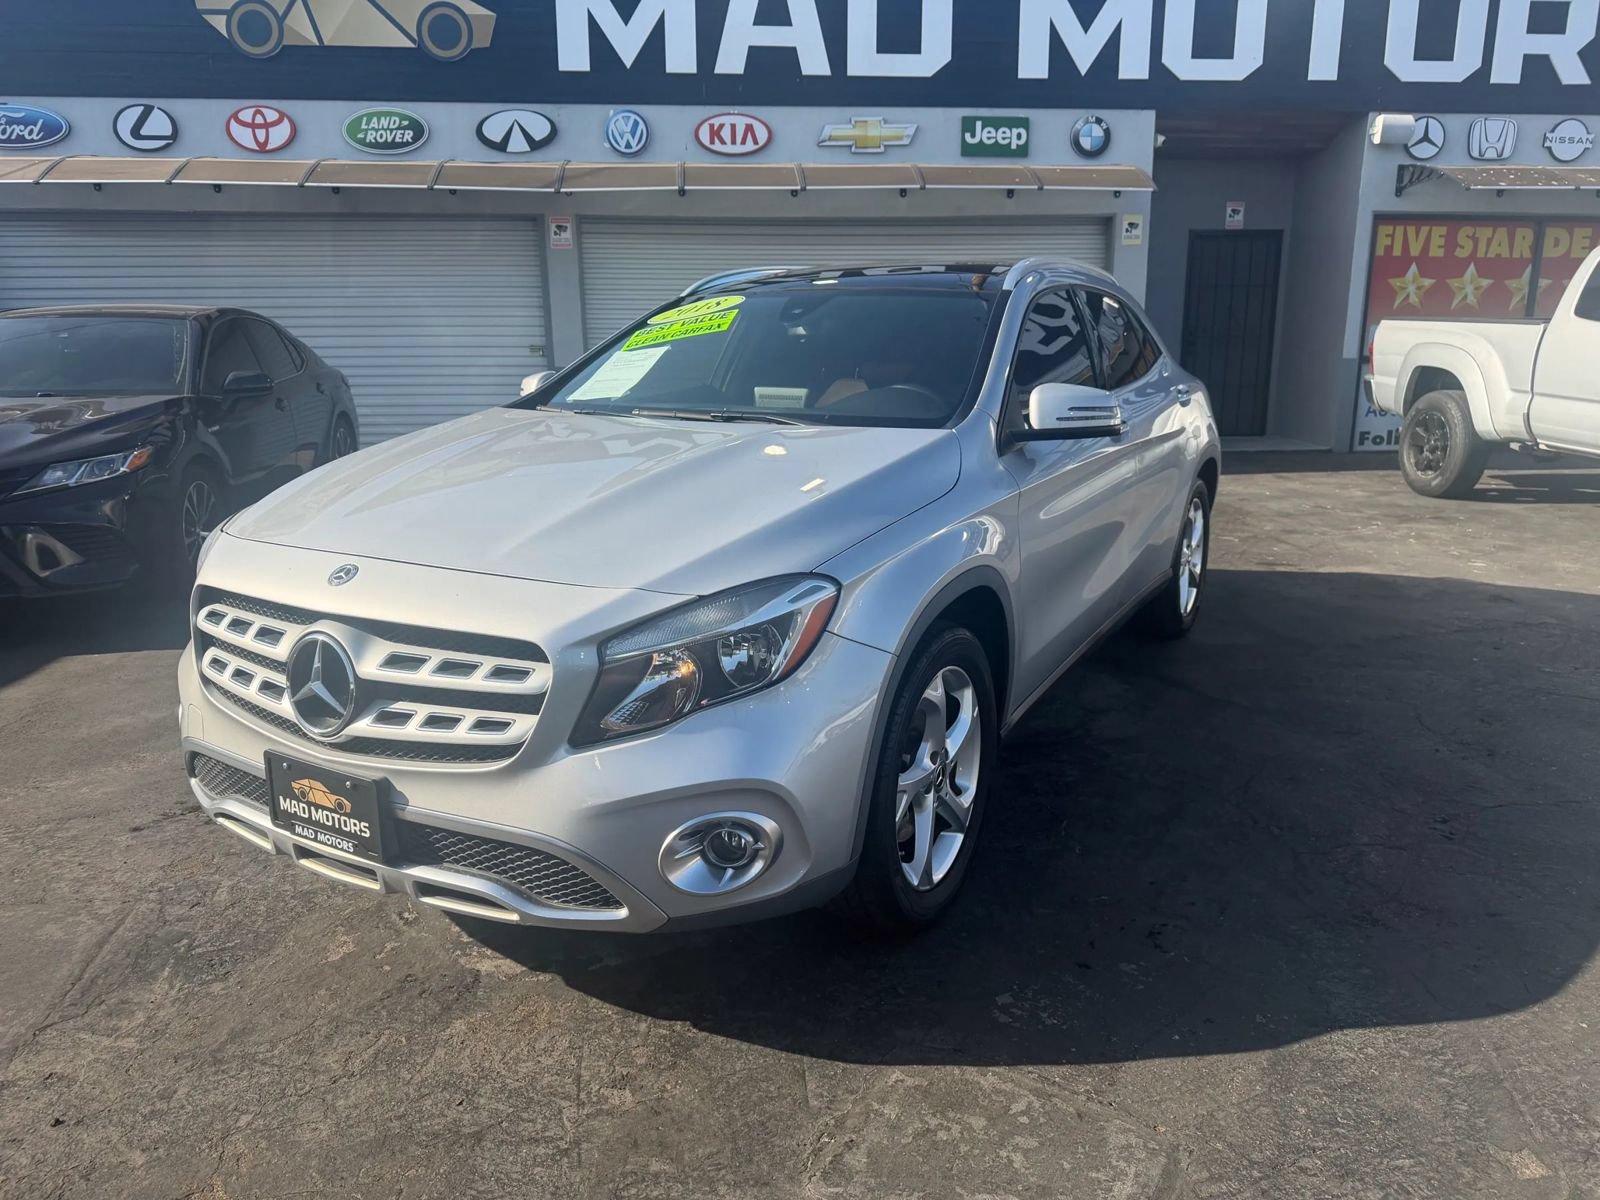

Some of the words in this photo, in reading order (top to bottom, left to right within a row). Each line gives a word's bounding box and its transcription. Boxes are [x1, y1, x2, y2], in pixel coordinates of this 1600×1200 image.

[361, 116, 400, 129] LAND
[708, 123, 760, 146] KIA
[964, 120, 1027, 149] Jeep
[366, 130, 413, 143] ROVER
[1545, 136, 1593, 145] NISSAN
[1375, 225, 1448, 257] FIVE
[1454, 226, 1535, 258] STAR
[625, 333, 669, 348] CLEAN
[670, 322, 727, 338] CARFAX
[635, 322, 674, 337] BEST
[679, 312, 730, 328] VALUE
[280, 795, 309, 819] MAD
[311, 806, 371, 838] MOTORS
[295, 824, 315, 839] MAD
[317, 832, 354, 853] MOTORS
